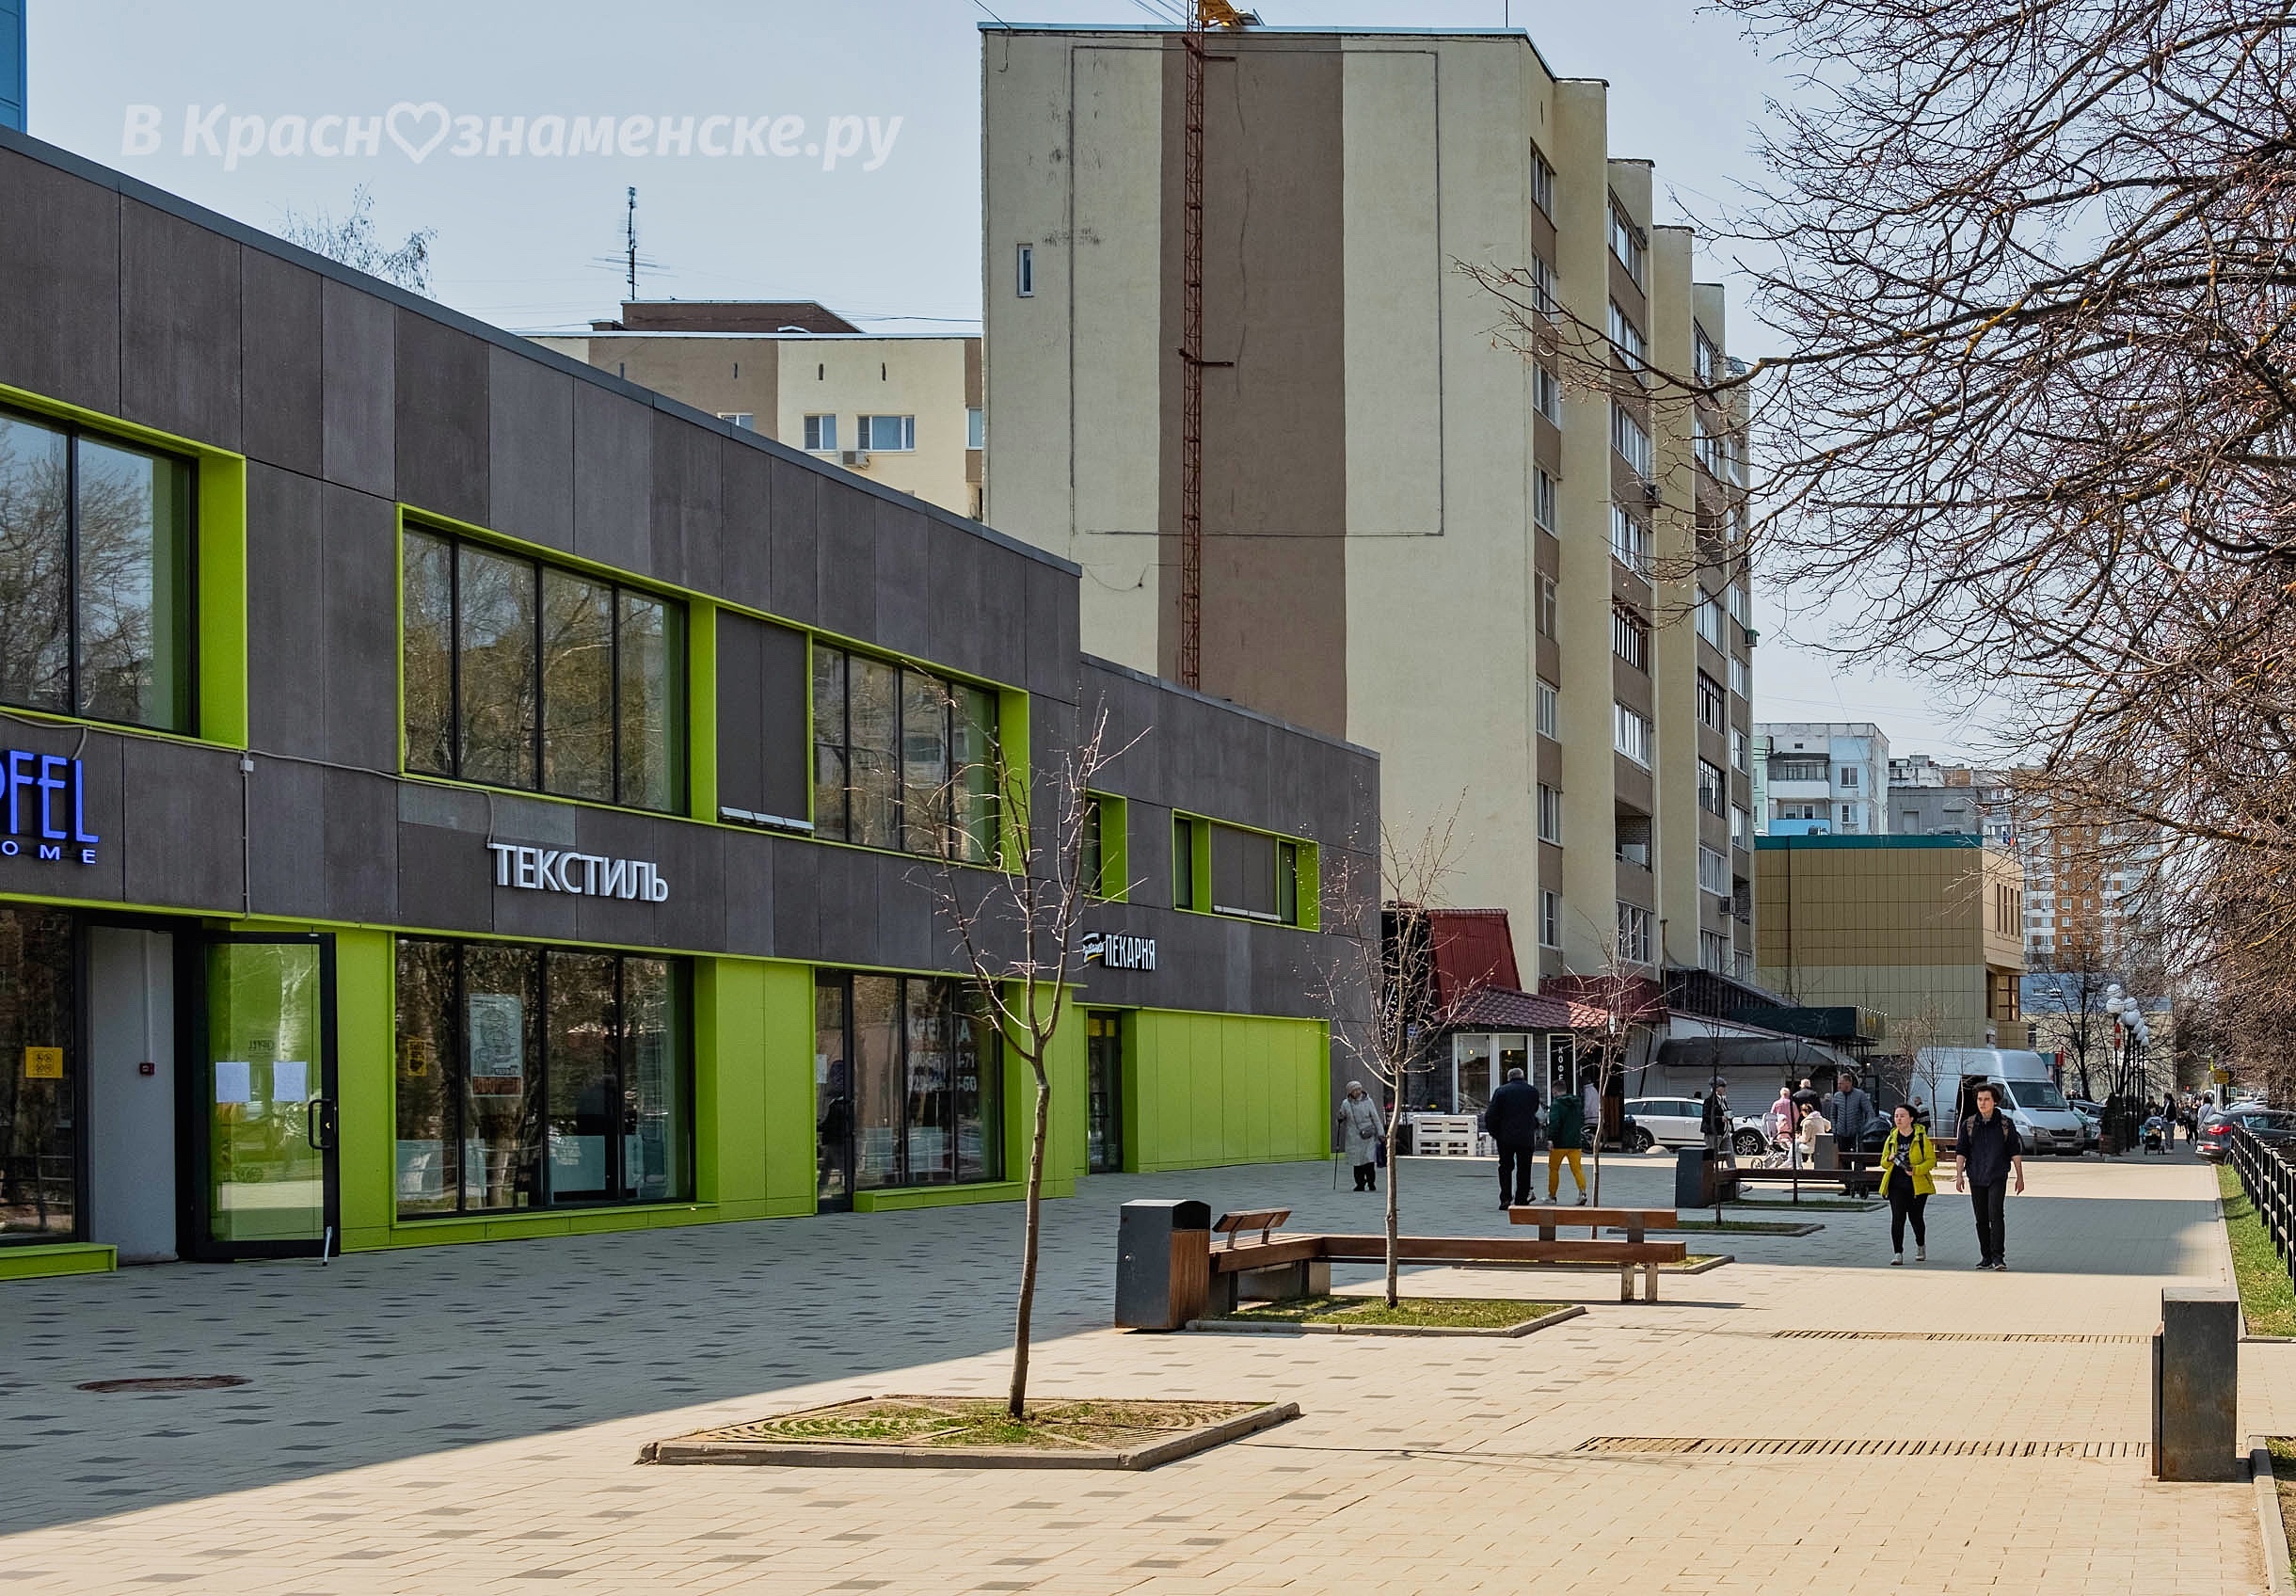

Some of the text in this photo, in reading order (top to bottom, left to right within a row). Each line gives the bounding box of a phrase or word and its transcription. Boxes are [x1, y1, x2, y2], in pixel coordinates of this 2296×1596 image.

[0, 750, 99, 843] FEL
[487, 843, 669, 902] ТЕКСТИЛЬ
[1105, 934, 1156, 970] ПЕКАРНЯ
